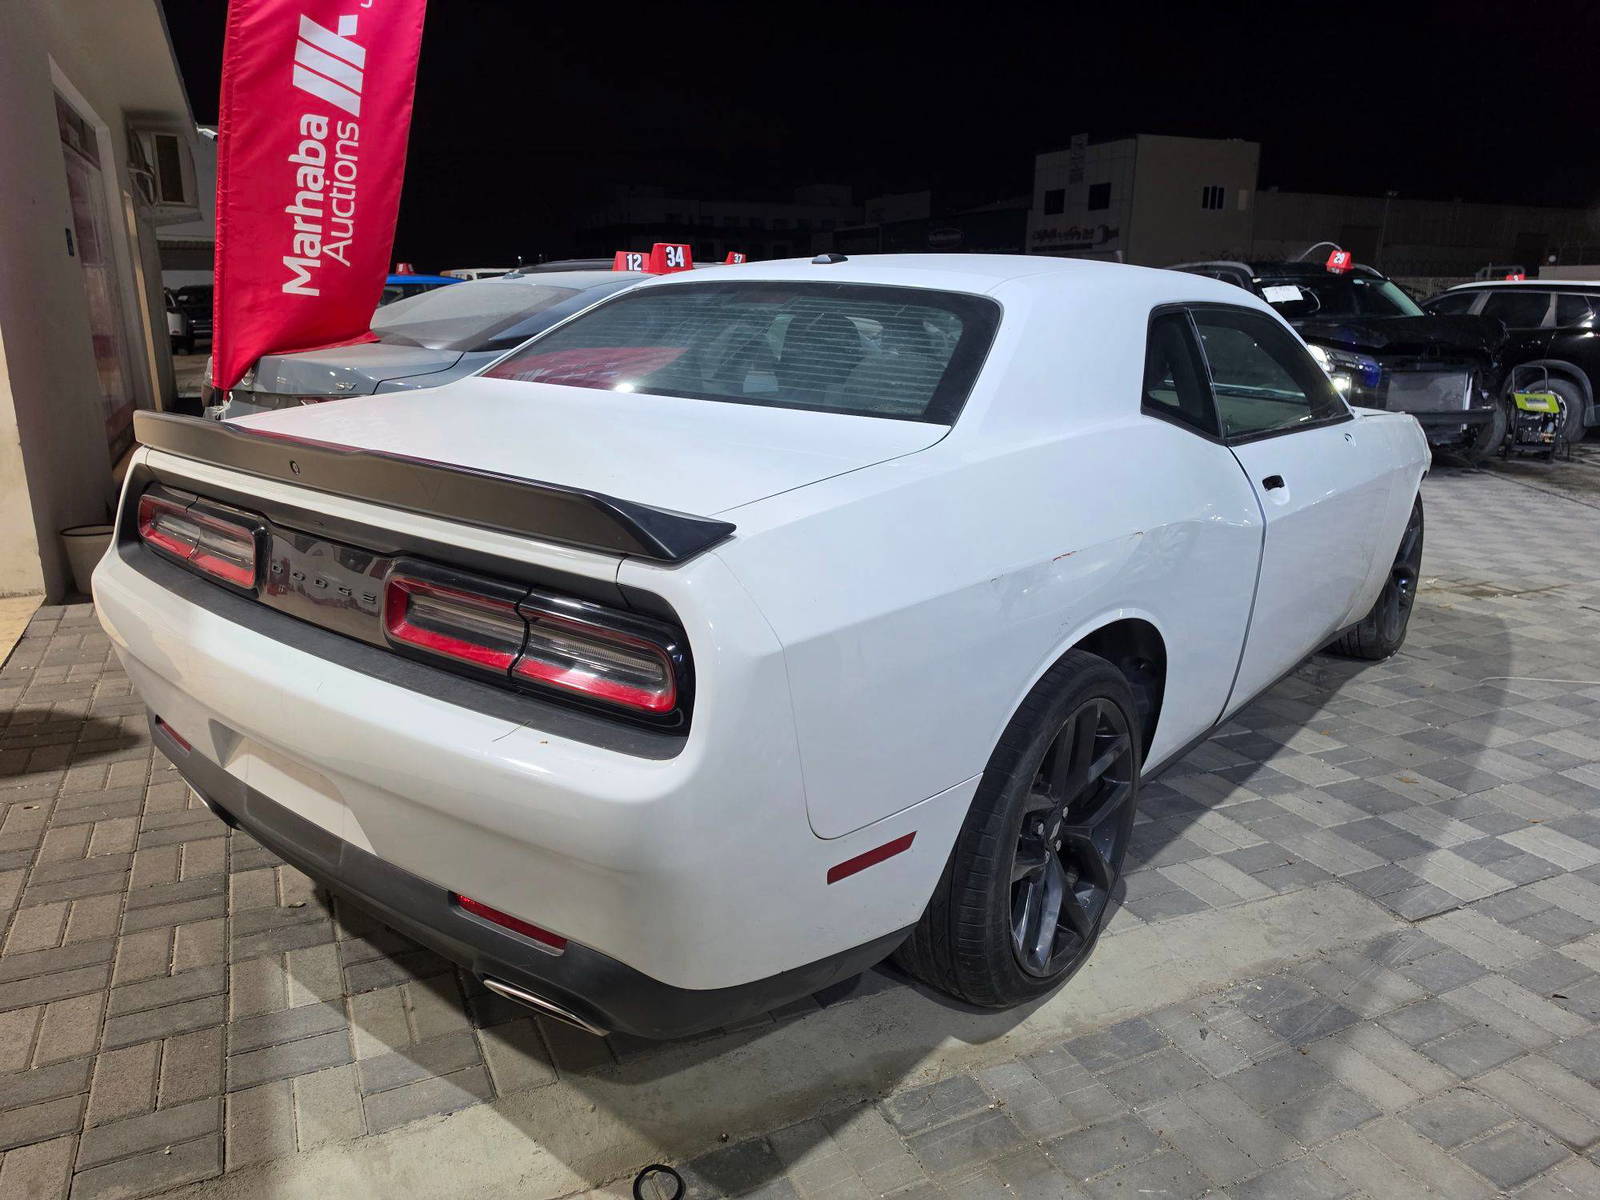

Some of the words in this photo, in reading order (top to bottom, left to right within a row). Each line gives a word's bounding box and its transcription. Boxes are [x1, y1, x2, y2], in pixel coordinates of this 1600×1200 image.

[282, 113, 329, 297] Marhaba
[322, 121, 360, 267] Auctions
[626, 253, 642, 271] 12
[665, 246, 685, 268] 34
[272, 563, 377, 605] DODGE
